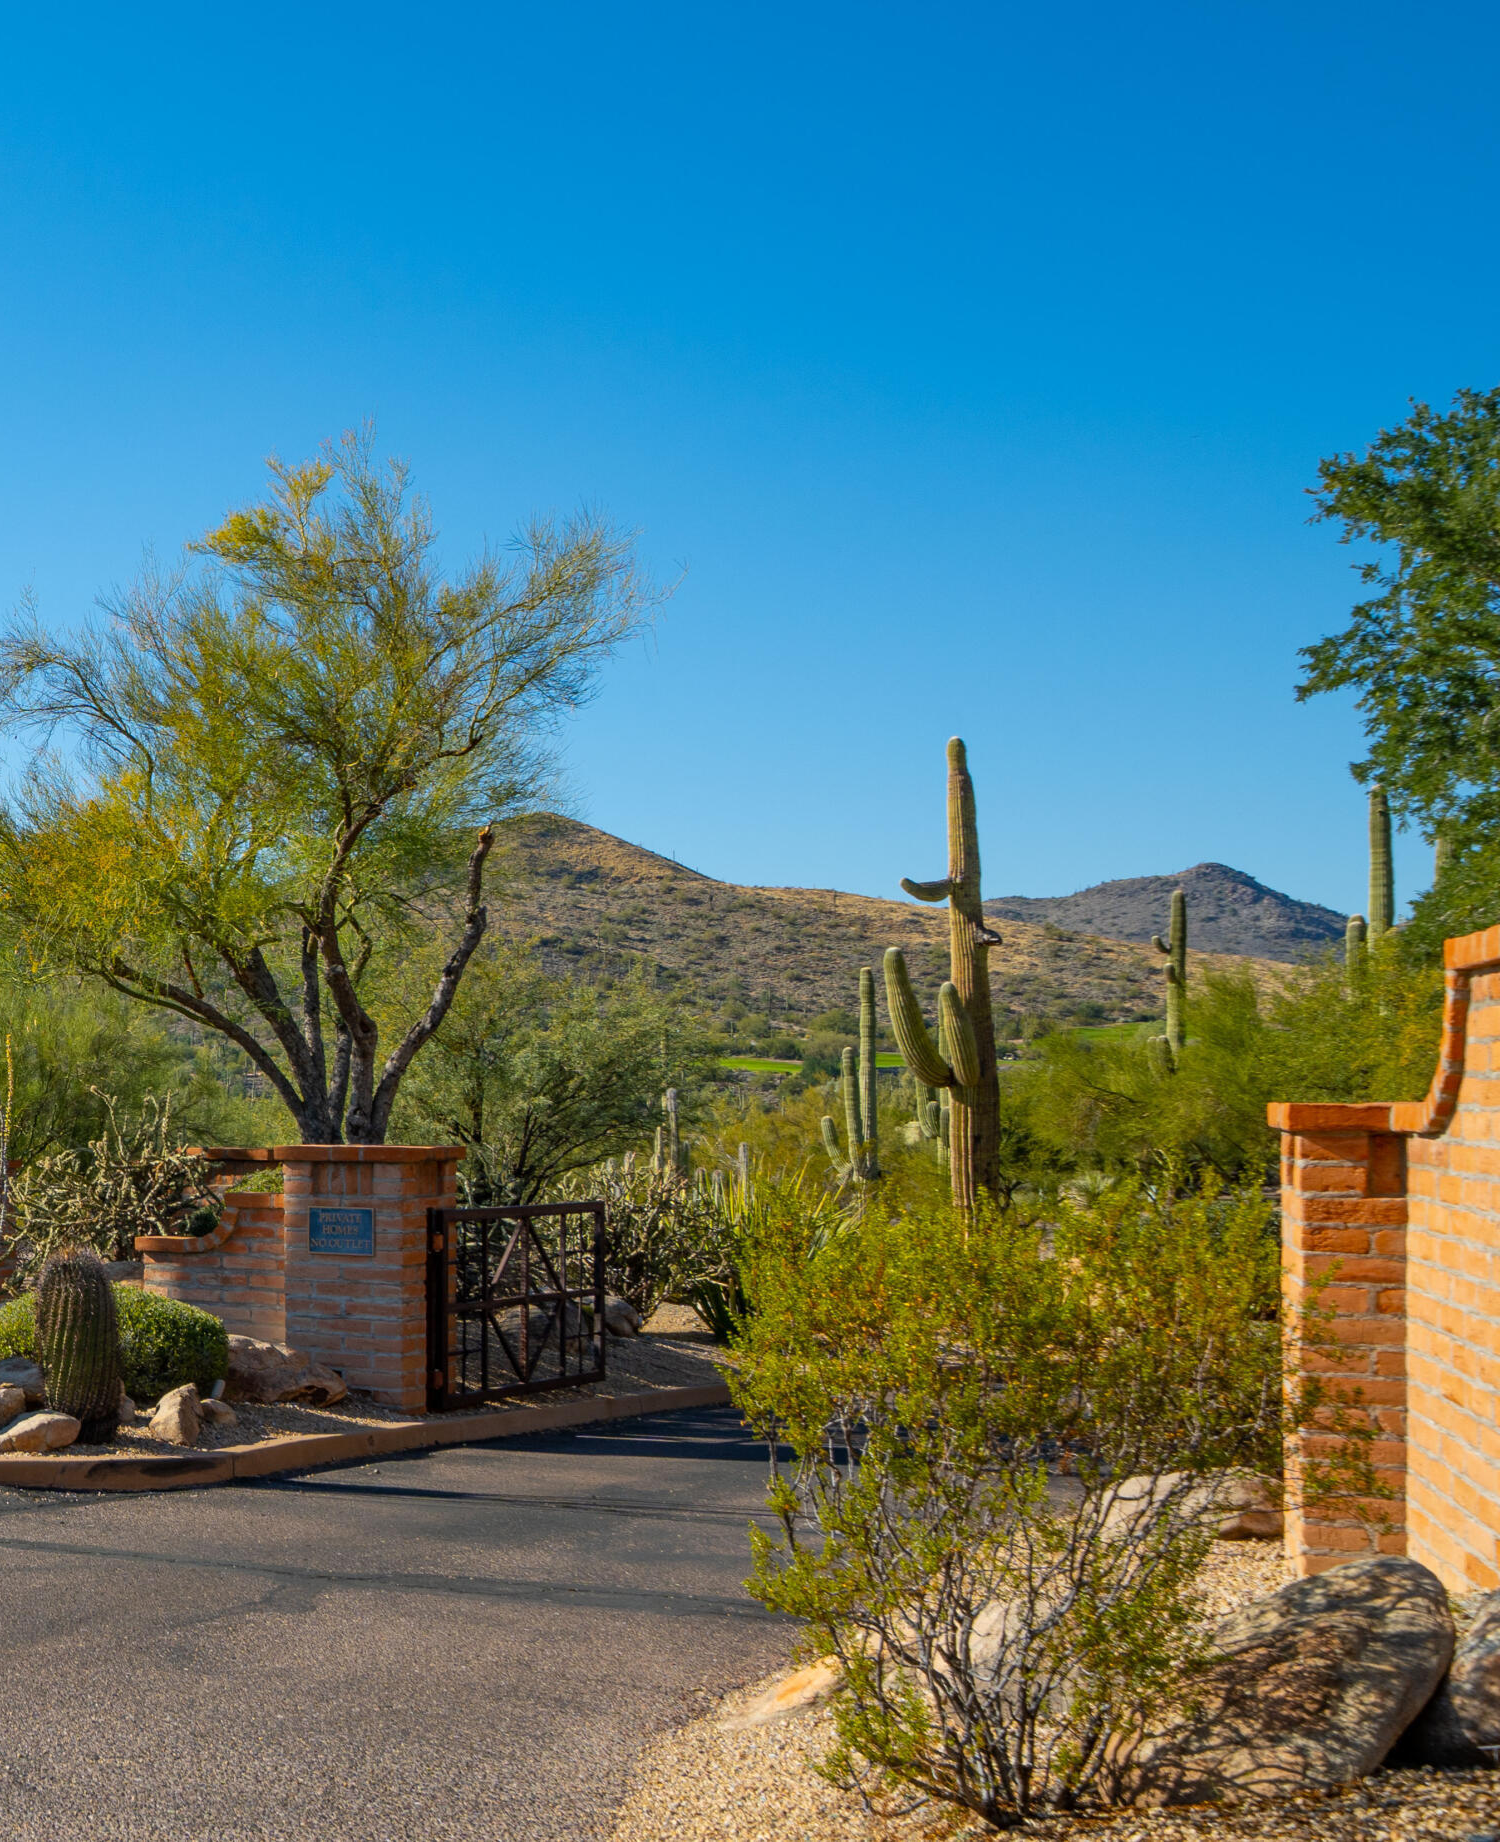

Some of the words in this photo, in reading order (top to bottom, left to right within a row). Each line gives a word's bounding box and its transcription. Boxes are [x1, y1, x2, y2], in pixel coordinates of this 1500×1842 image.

[318, 1212, 363, 1224] PRIVATE
[322, 1224, 359, 1235] HOMES
[311, 1238, 327, 1248] NO
[328, 1239, 371, 1249] OUTLET
